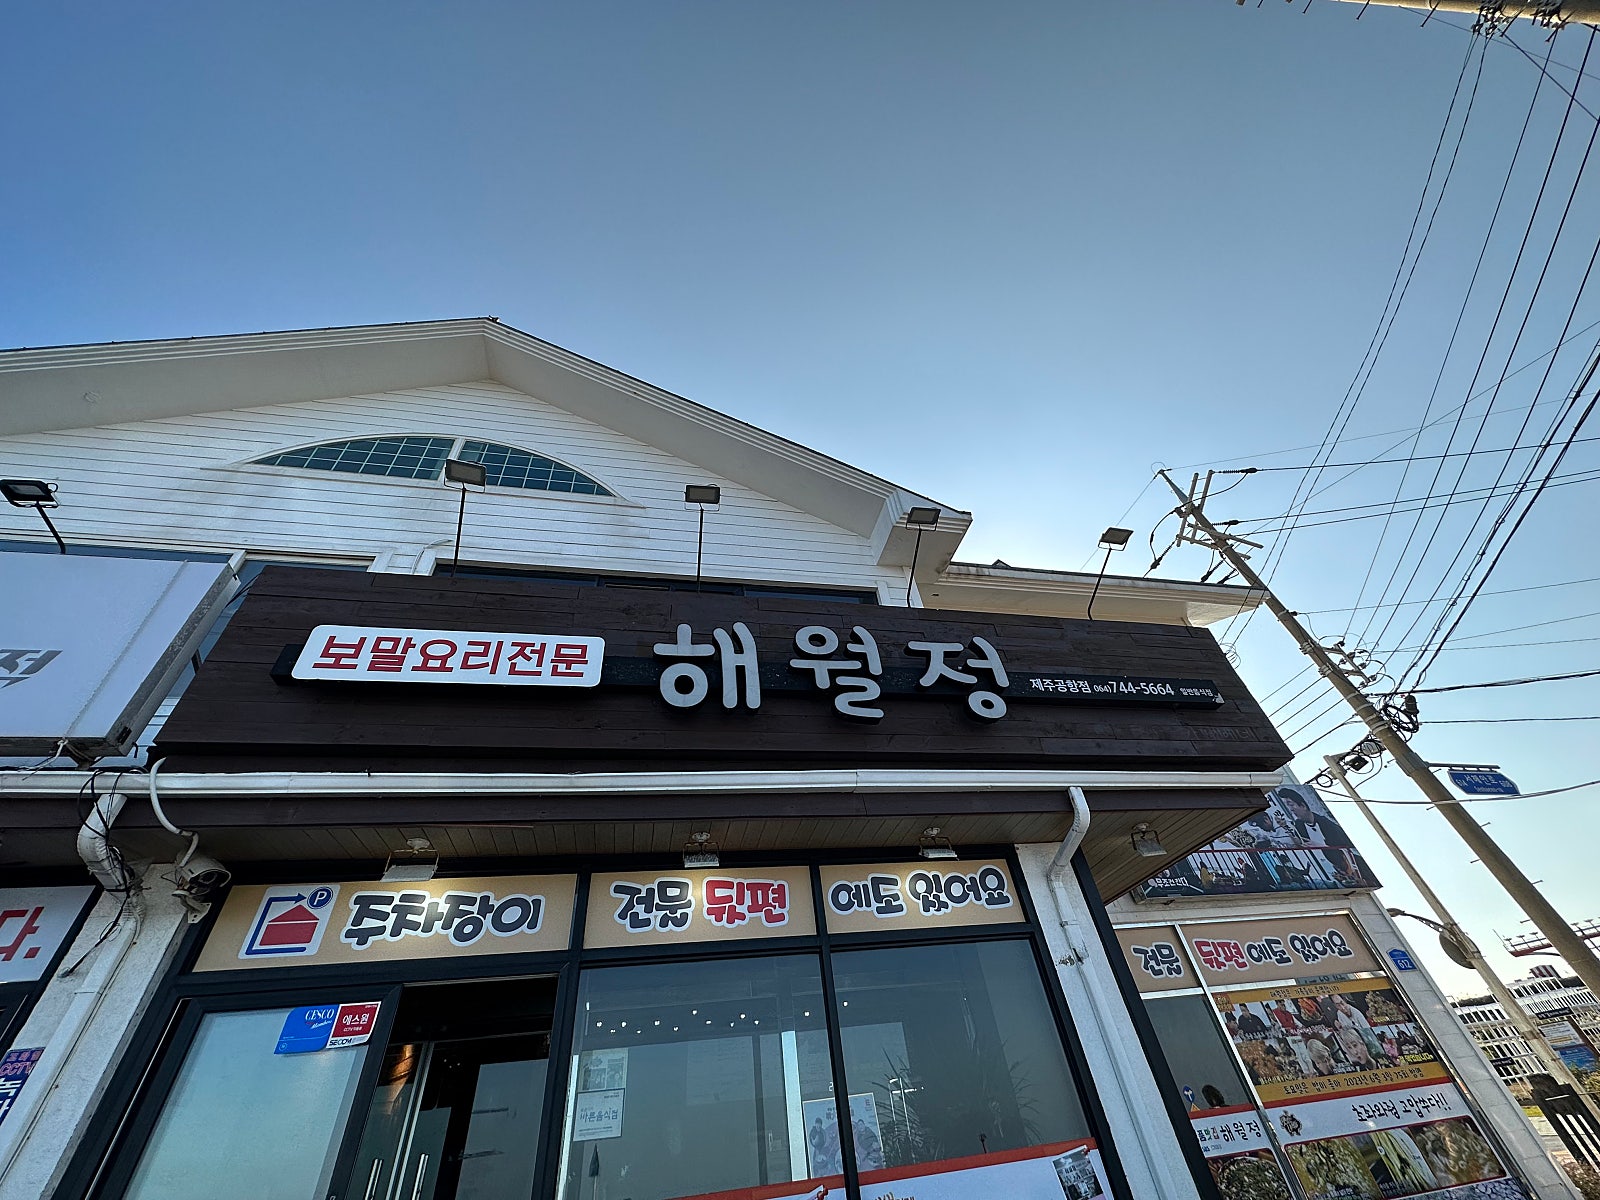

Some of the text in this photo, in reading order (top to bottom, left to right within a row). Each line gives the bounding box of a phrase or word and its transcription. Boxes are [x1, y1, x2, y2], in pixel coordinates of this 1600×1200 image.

[312, 635, 589, 678] 보말요리전문
[653, 621, 1010, 719] 해월정
[1029, 678, 1092, 694] 제주공항점
[1179, 687, 1214, 698] 일반음식점
[343, 864, 1014, 947] 주차장이 건물 뒷편 에도 있어요
[1130, 942, 1184, 978] 건물
[1287, 928, 1354, 964] 있어요
[1397, 959, 1412, 969] 612
[305, 1008, 335, 1021] CESCO
[342, 1013, 370, 1026] 에스원
[329, 1038, 352, 1046] SECOM
[1283, 1084, 1309, 1095] 토요일은
[1345, 1075, 1368, 1087] 2023년
[1370, 1072, 1381, 1083] 6월
[1382, 1070, 1393, 1082] 3일
[579, 1109, 619, 1123] 바른음식점
[1400, 1092, 1452, 1118] 고맙쑤다!!
[1220, 1119, 1262, 1143] 해월정
